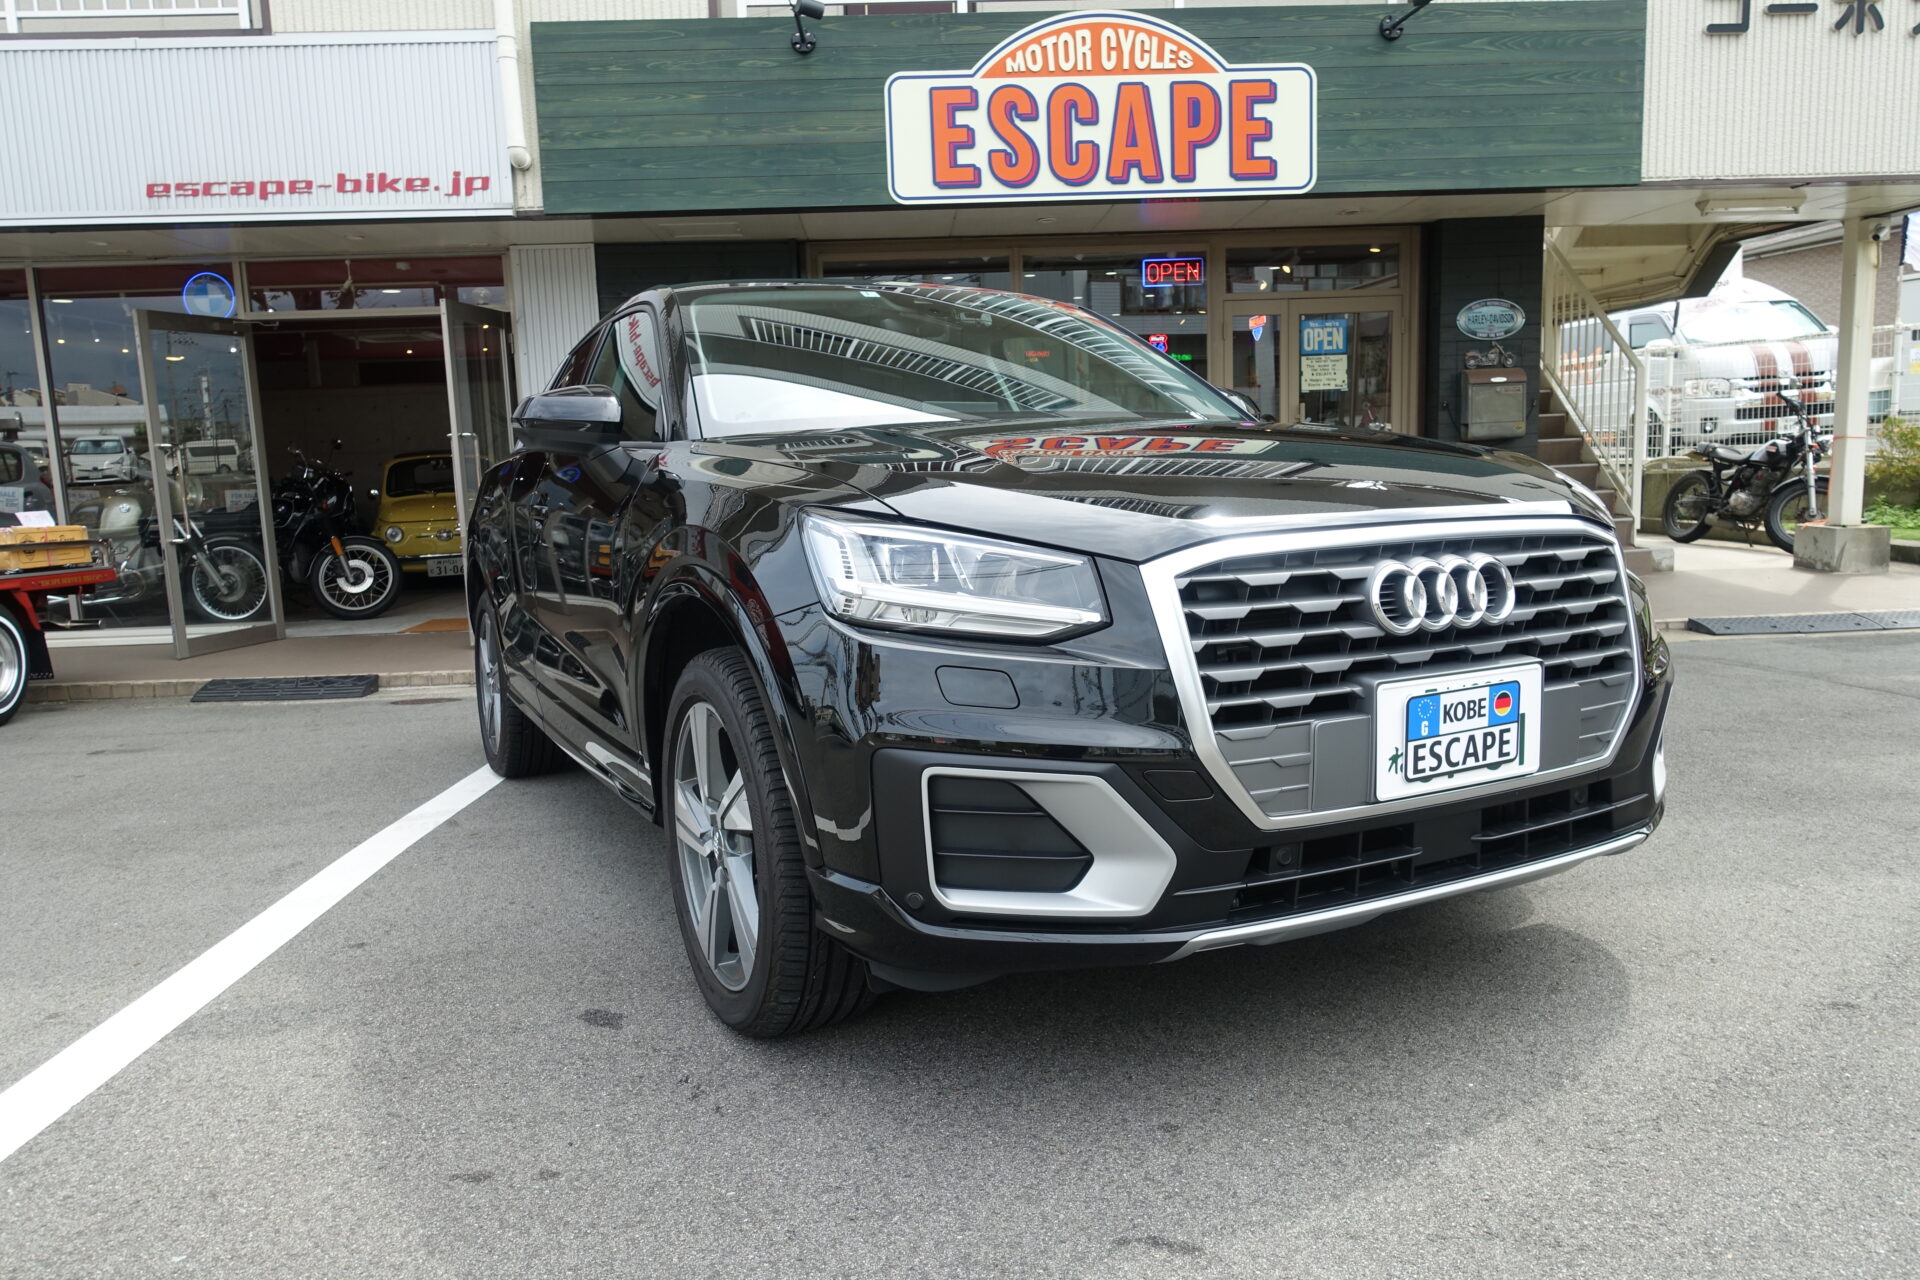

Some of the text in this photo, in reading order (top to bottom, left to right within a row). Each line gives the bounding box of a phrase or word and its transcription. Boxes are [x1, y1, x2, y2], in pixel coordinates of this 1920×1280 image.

[1005, 27, 1194, 73] MOTOR CYCLES
[929, 79, 1277, 189] ESCAPE
[146, 171, 490, 200] escape-bike.jp
[1146, 262, 1200, 282] OPEN
[1303, 327, 1344, 351] OPEN
[1443, 698, 1487, 724] KOBE
[1420, 720, 1429, 736] G
[1412, 727, 1512, 776] ESCAPE
